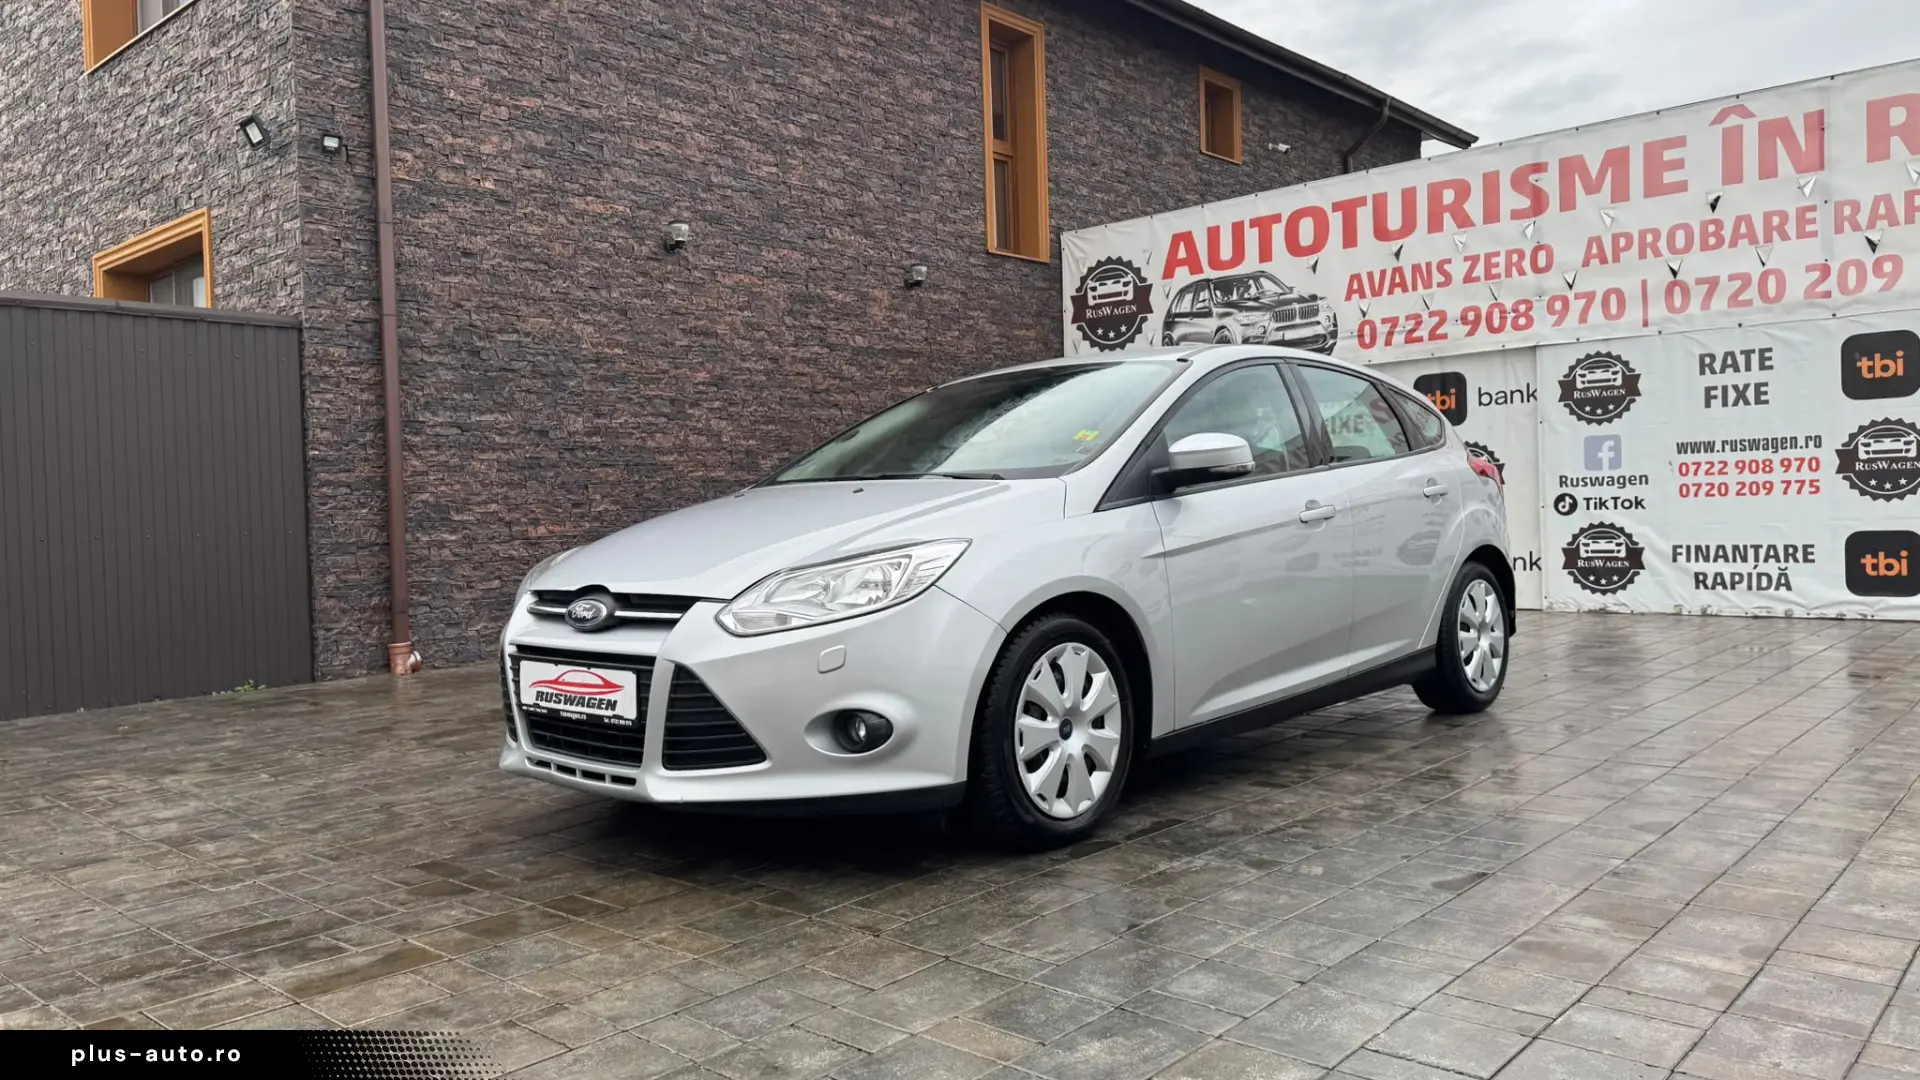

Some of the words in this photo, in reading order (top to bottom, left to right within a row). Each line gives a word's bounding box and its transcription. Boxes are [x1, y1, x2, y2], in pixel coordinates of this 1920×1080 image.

[1161, 135, 1688, 280] AUTOTURISME
[1708, 103, 1825, 186] ÎN
[1344, 258, 1452, 301] AVANS
[1462, 243, 1554, 285] ZERO
[1581, 204, 1819, 268] APROBARE
[1357, 309, 1448, 349] 0722
[1461, 298, 1534, 337] 908
[1546, 287, 1626, 327] 970
[1664, 268, 1786, 315] 0720
[1804, 254, 1903, 300] 209
[1698, 347, 1774, 376] RATE
[1856, 350, 1904, 379] tbi
[1478, 382, 1538, 407] bank
[1704, 381, 1770, 409] FIXE
[1676, 435, 1822, 454] www.ruswagen.ro
[1678, 460, 1729, 477] 0722
[1734, 458, 1774, 475] 908
[1779, 456, 1821, 473] 970
[1558, 473, 1650, 490] Ruswagen
[1679, 482, 1729, 498] 0720
[1735, 480, 1774, 496] 209
[1780, 479, 1821, 495] 775
[1583, 496, 1646, 511] TikTok
[1513, 551, 1542, 571] nk
[1860, 551, 1909, 577] tbi
[571, 603, 596, 620] Ford
[535, 690, 618, 712] RUSWAGEN
